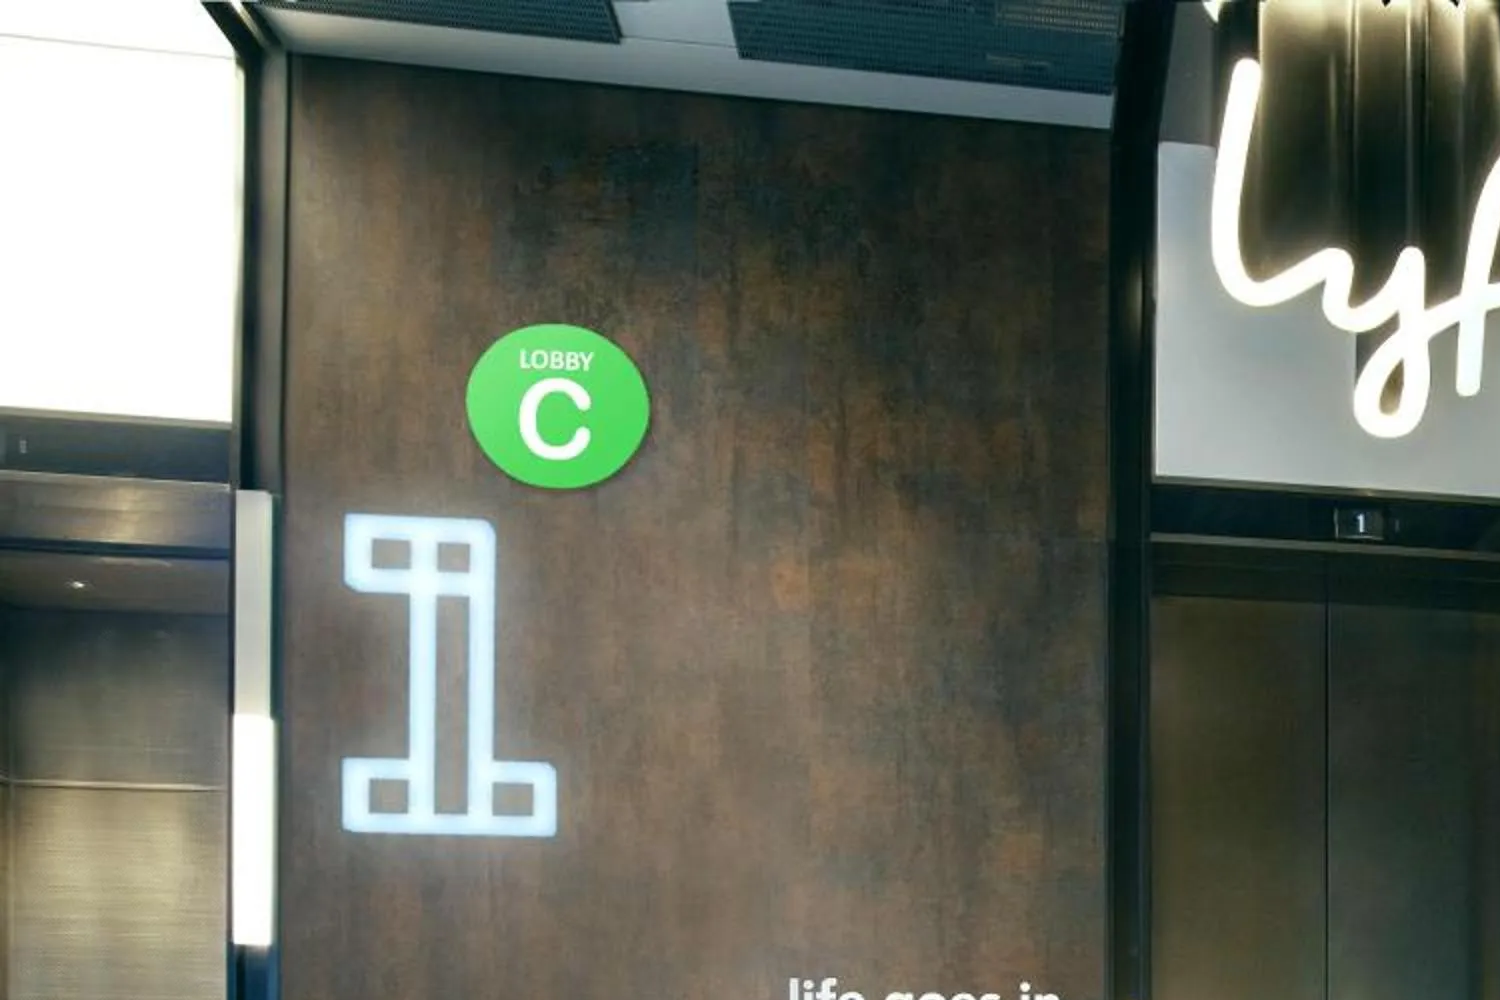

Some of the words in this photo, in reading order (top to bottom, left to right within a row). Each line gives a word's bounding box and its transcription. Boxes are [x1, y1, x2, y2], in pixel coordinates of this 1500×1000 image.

[519, 349, 594, 371] LOBBY
[518, 377, 592, 461] C
[1356, 513, 1366, 533] 1
[341, 512, 557, 837] 1
